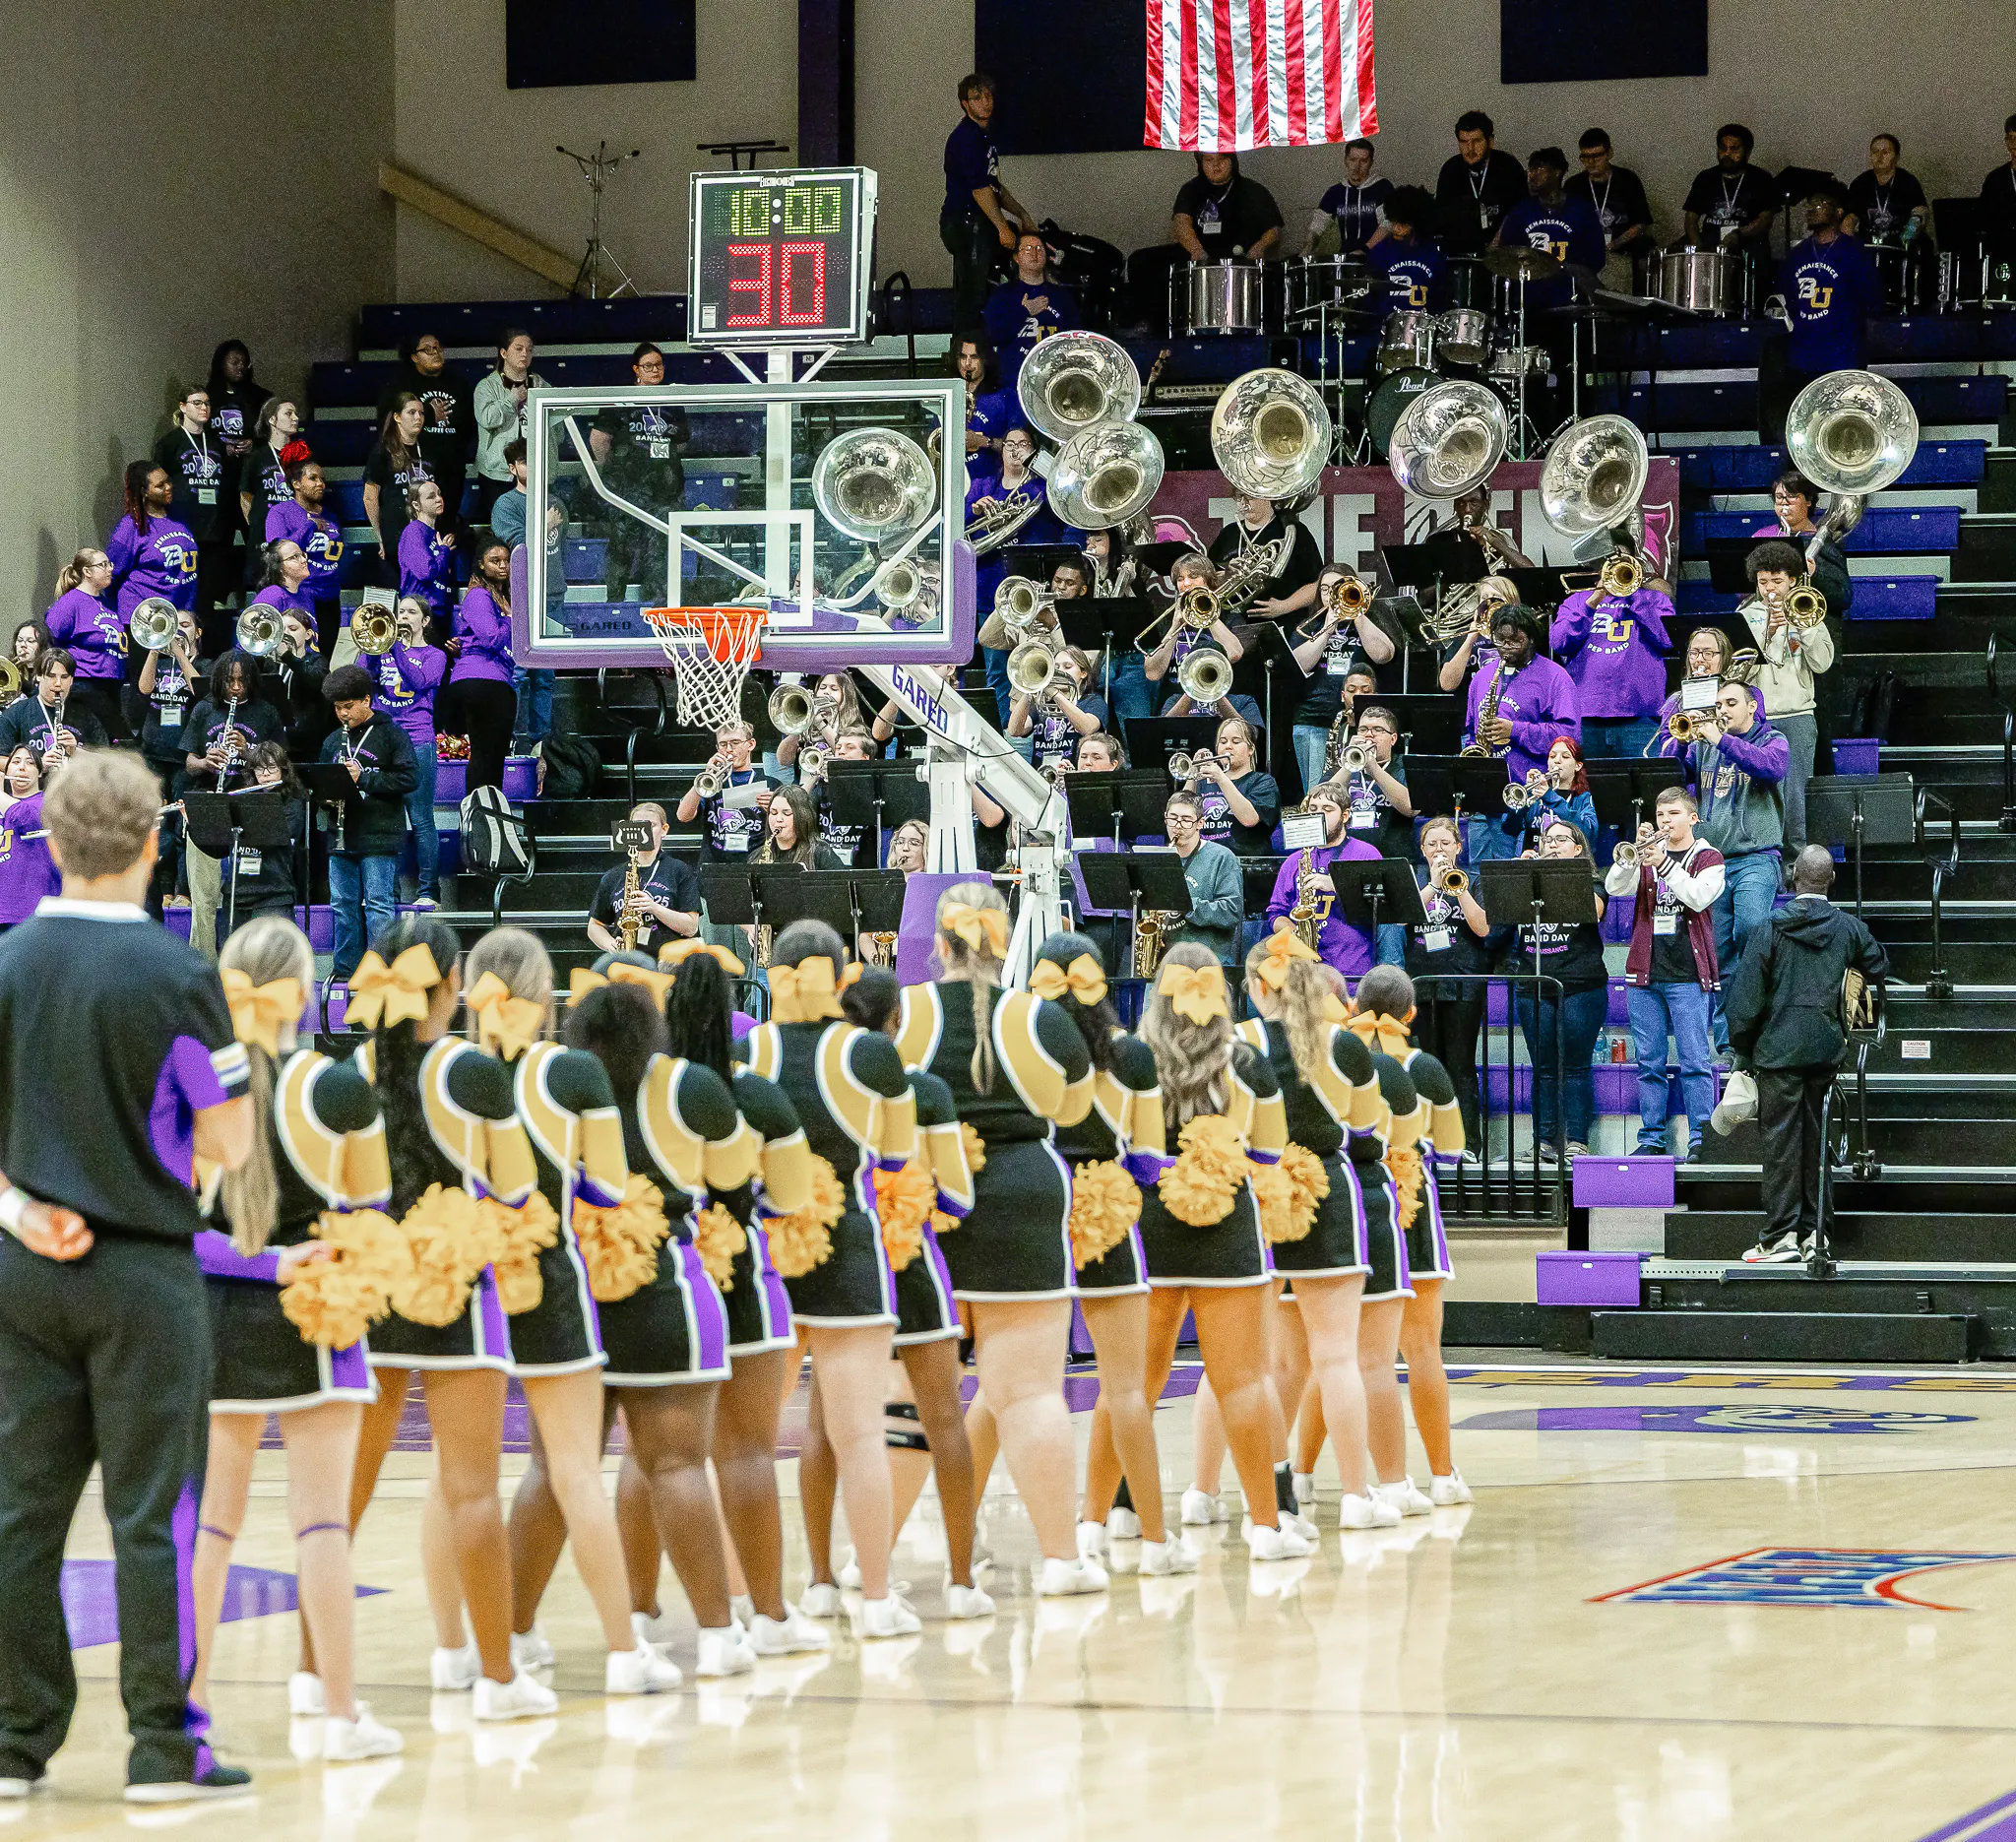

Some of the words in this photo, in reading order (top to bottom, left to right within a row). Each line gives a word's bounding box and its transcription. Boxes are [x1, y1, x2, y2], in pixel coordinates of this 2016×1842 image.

[730, 186, 842, 237] 10:00
[1525, 219, 1573, 234] RENAISSANCE
[1795, 262, 1839, 280] RENAISSANCE
[726, 241, 826, 327] 30
[1798, 277, 1834, 308] BU
[1807, 308, 1829, 320] BAND
[1019, 346, 1030, 356] PE
[1394, 376, 1428, 393] Pearl
[629, 421, 643, 432] 20
[182, 462, 195, 475] 20
[263, 478, 274, 489] 20
[395, 473, 409, 484] 20
[306, 533, 345, 561] BU
[159, 543, 198, 573] BU
[181, 572, 198, 585] BAND
[580, 620, 631, 630] GARED
[1590, 612, 1634, 642] BU
[1588, 643, 1603, 654] PEP
[1605, 642, 1630, 655] BAND
[172, 694, 189, 703] DAY
[378, 694, 391, 708] PEP
[392, 698, 414, 708] BAND
[893, 665, 949, 734] GARED
[231, 758, 247, 767] DAY
[745, 819, 762, 832] 25
[820, 833, 842, 842] BAND
[654, 895, 670, 908] 25
